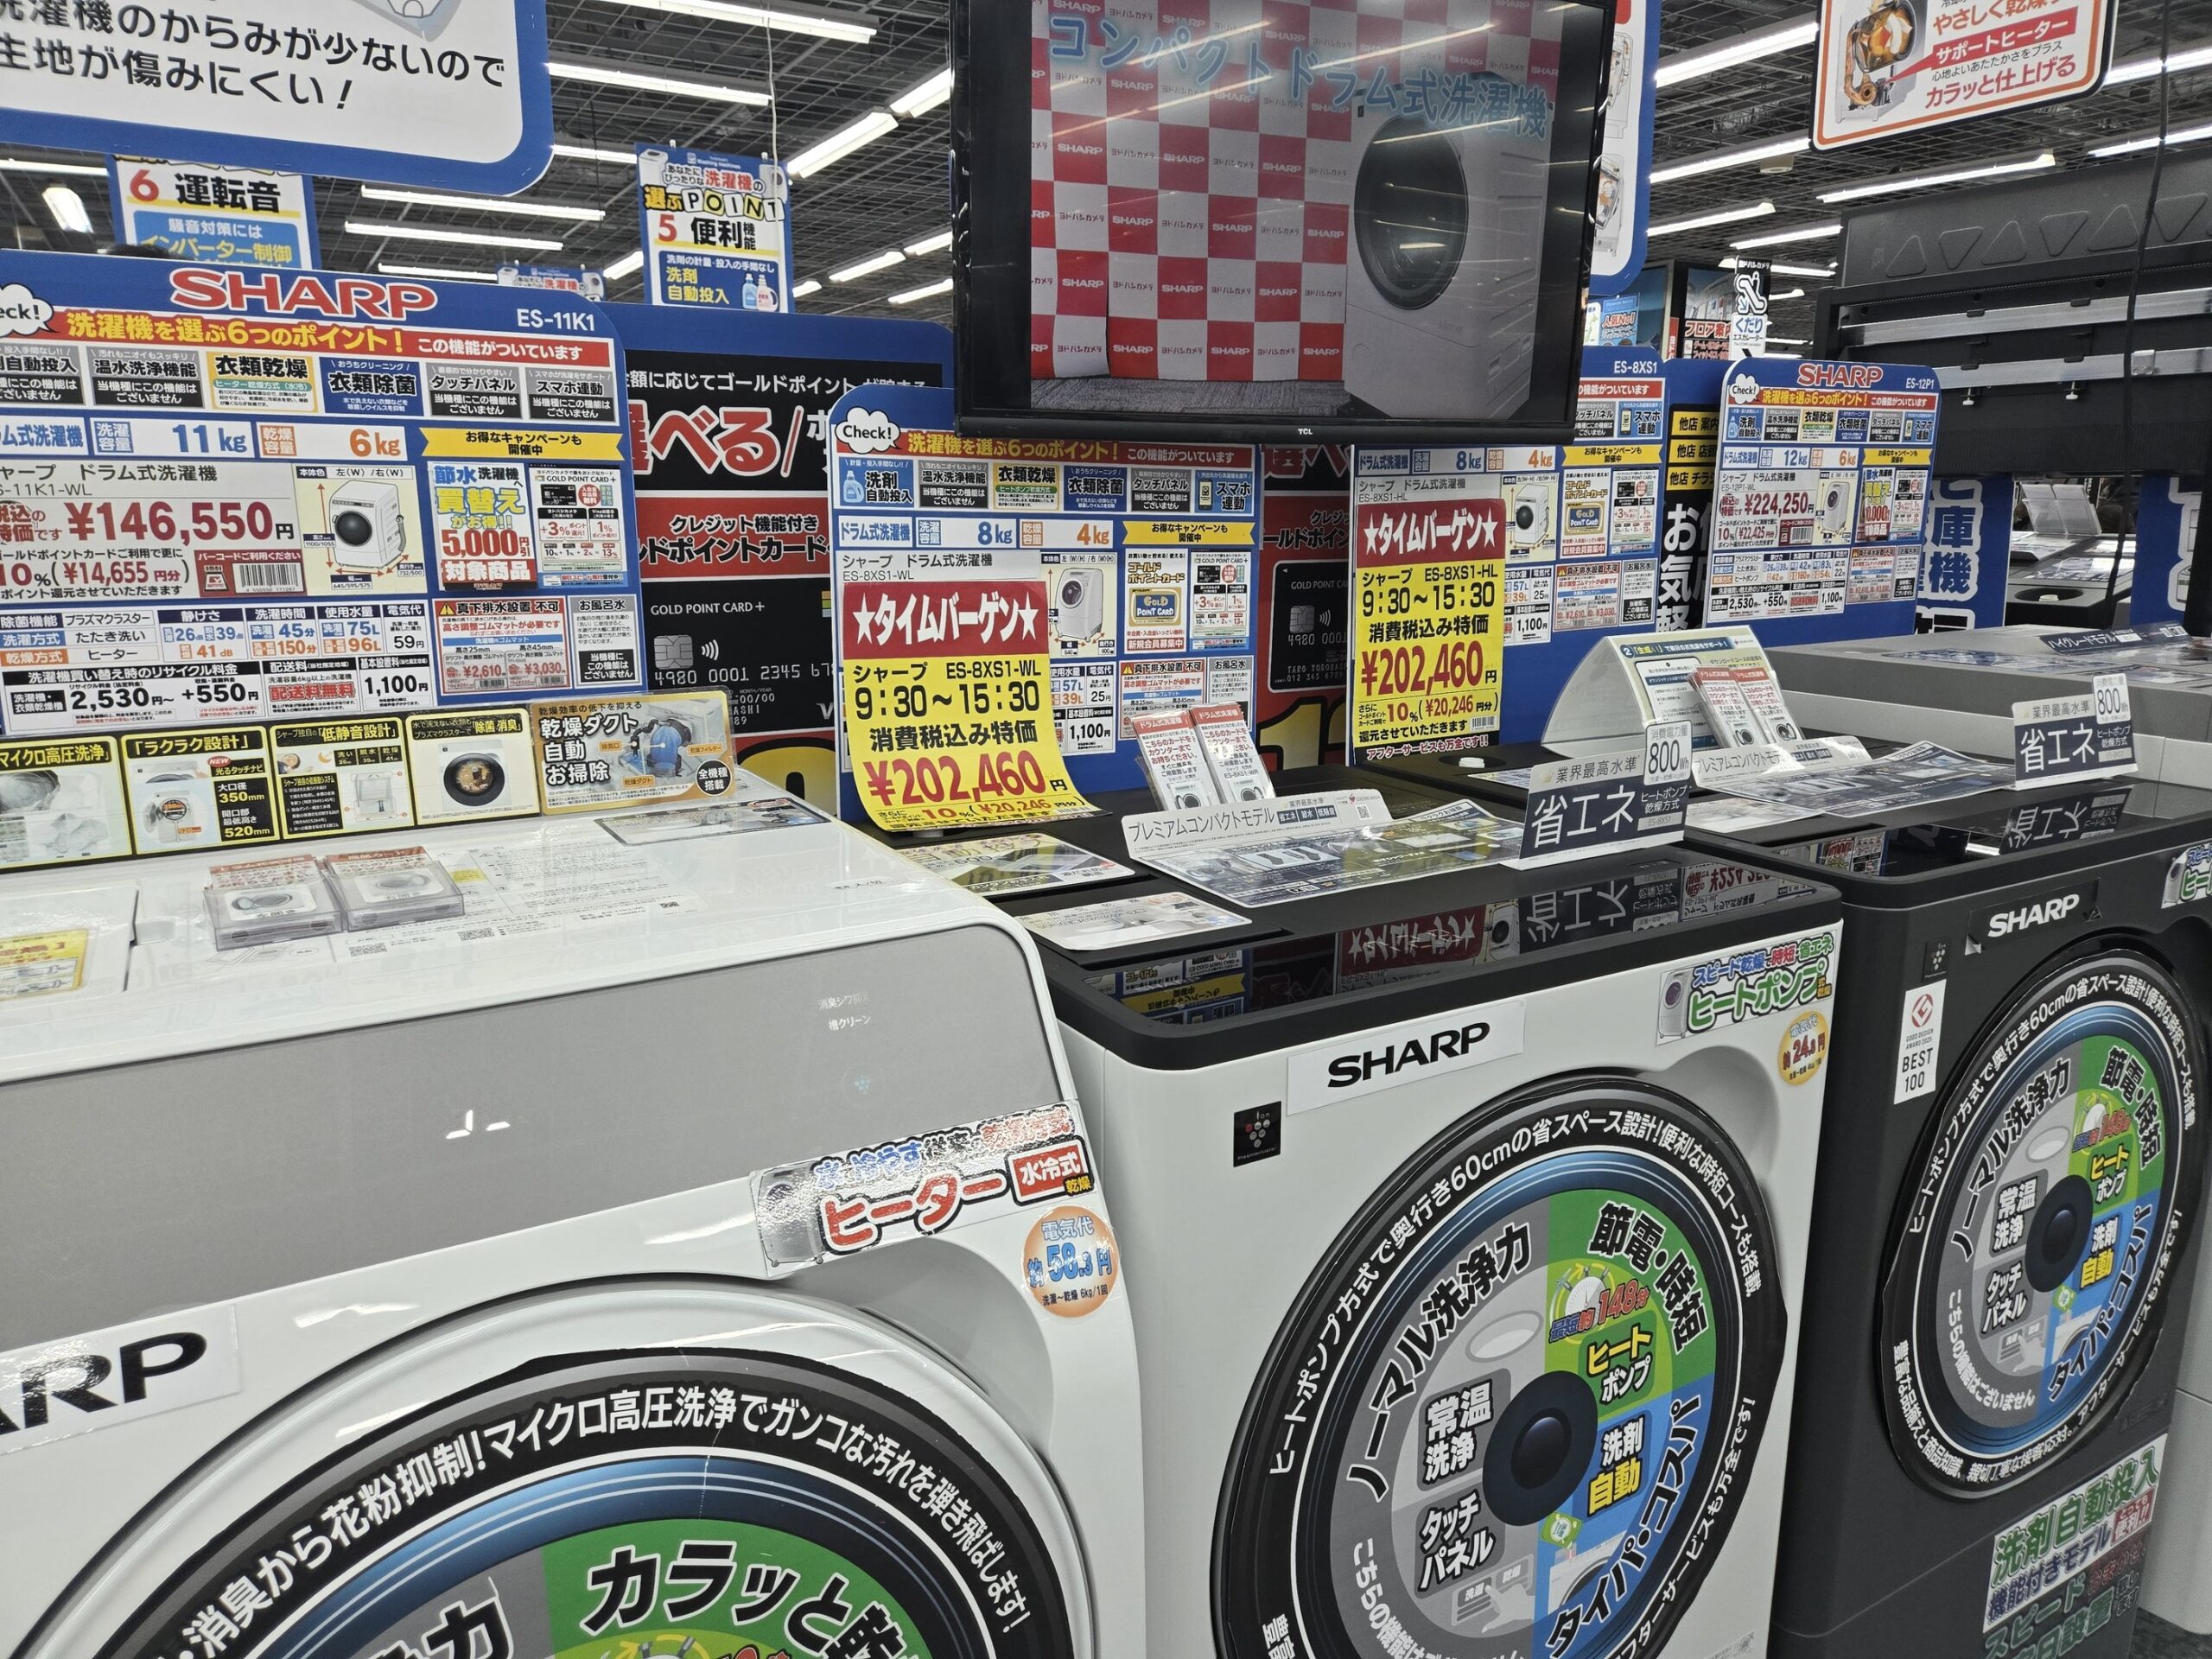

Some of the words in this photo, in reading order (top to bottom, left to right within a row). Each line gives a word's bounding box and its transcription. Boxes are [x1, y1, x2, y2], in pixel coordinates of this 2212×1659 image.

[1936, 20, 2069, 65] サポートヒーター
[1932, 41, 2063, 82] 心地よいあたたかさをプラス
[1924, 54, 2077, 110] カラッと仕上げる
[1058, 143, 1103, 156] SHARP
[129, 168, 160, 202] 6
[174, 173, 282, 214] 運転音
[1058, 211, 1105, 223] ヨドバシカメラ
[1111, 214, 1154, 227] SHARP
[168, 217, 264, 239] 騒音対策には
[658, 213, 677, 243] 5
[1211, 222, 1253, 234] SHARP
[1306, 227, 1345, 239] SHARP
[666, 266, 698, 284] 洗剤
[1061, 276, 1104, 289] SHARP
[170, 267, 438, 321] SHARP
[667, 285, 730, 305] 自動投入
[1112, 280, 1154, 291] ヨドバシカメラ
[1161, 283, 1204, 295] SHARP
[516, 308, 597, 332] ES-11K1
[1735, 317, 1764, 333] くだり
[417, 337, 583, 361] この機能がついています
[1056, 344, 1103, 353] ヨドバシカメラ
[1112, 343, 1154, 354] SHARP
[1302, 346, 1340, 356] SHARP
[94, 358, 198, 378] 温水洗浄機能
[214, 354, 309, 378] 衣類乾燥
[1613, 359, 1658, 374] ES-8XS1
[1797, 362, 1885, 389] SHARP
[97, 380, 198, 395] 当機種にこの機能は
[328, 372, 417, 397] 衣類除菌
[431, 374, 517, 392] タッチパネル
[537, 379, 604, 397] スマホ連動
[1905, 377, 1936, 390] ES-12P1
[116, 392, 183, 404] ございません
[842, 424, 893, 441] Check!
[1679, 416, 1700, 430] 他店
[465, 431, 582, 447] お得なキャンペーンも
[507, 443, 543, 456] 開催中
[1127, 447, 1236, 464] この機能がついています
[79, 463, 219, 482] ドラム式洗濯機
[921, 470, 987, 486] 温水洗浄機能
[1133, 477, 1189, 492] タッチパネル
[1216, 480, 1252, 497] スマホ
[1358, 480, 1395, 493] シャープ
[1404, 479, 1466, 492] ドラム式洗濯機
[435, 486, 525, 515] 買替え
[866, 489, 913, 504] 自動投入
[671, 513, 820, 534] クレジット機能付き
[840, 522, 911, 542] ドラム式洗濯機
[1151, 523, 1229, 535] お得なキャンペーンも
[842, 554, 893, 569] シャープ
[906, 552, 994, 568] ドラム式洗濯機
[842, 569, 915, 582] ES-8XS1-WL
[1362, 569, 1413, 588] シャープ
[1424, 564, 1499, 582] ES-8XS1-HL
[1, 584, 181, 600] ポイント還元させていただきます
[65, 613, 151, 626] プラズマクラスター
[181, 608, 221, 622] 静けさ
[254, 607, 307, 620] 洗濯時間
[324, 606, 374, 618] 使用水量
[386, 603, 422, 616] 電気代
[579, 597, 626, 612] お風呂水
[651, 603, 683, 616] GOLD
[685, 602, 721, 614] POINT
[722, 601, 753, 613] CARD
[75, 630, 147, 644] たたき洗い
[1369, 613, 1490, 644] 消費税込み特価
[88, 649, 138, 661] ヒーター
[28, 663, 238, 685] 洗濯機買い替え時のリサイクル料金
[654, 669, 698, 686] 4980
[760, 664, 802, 680] 2345
[853, 662, 929, 684] シャープ
[945, 659, 1043, 680] ES-8XS1-WL
[538, 700, 643, 715] 乾燥効率の低下を抑える
[2031, 699, 2091, 720] 業界最高水準
[540, 713, 640, 739] 乾燥ダクト
[868, 719, 1039, 753] 消費税込み特価
[1358, 719, 1468, 744] 還元させていただきます
[543, 740, 587, 763] 自動
[2018, 721, 2096, 773] 省エネ
[546, 763, 610, 786] お掃除
[697, 766, 729, 779] 全機種
[1555, 756, 1638, 785] 業界最高水準
[218, 782, 247, 793] 大口径
[703, 777, 726, 791] 搭載
[1641, 787, 1688, 803] ヒートポンプ
[1644, 798, 1681, 814] 乾燥方式
[1128, 806, 1276, 843] プレミアムコンパクトモデル
[1530, 783, 1637, 850] 省エネ
[1987, 893, 2081, 938] SHARP
[1687, 957, 1827, 1033] ヒートポンプ
[1326, 1020, 1491, 1089] SHARP
[1901, 1046, 1935, 1073] BEST
[1904, 1070, 1926, 1093] 100
[820, 1169, 1009, 1257] ヒーター
[1020, 1152, 1084, 1186] 水冷式
[1996, 1175, 2039, 1221] 常温
[1041, 1216, 1095, 1242] 電気代
[1426, 1385, 1493, 1438] 常温
[1599, 1417, 1645, 1471] 洗剤
[1424, 1430, 1477, 1483] 洗浄
[1587, 1456, 1643, 1516] 自動
[1419, 1497, 1482, 1554] タッチ
[1990, 1444, 2160, 1588] 洗剤自動投入
[1418, 1531, 1494, 1591] パネル
